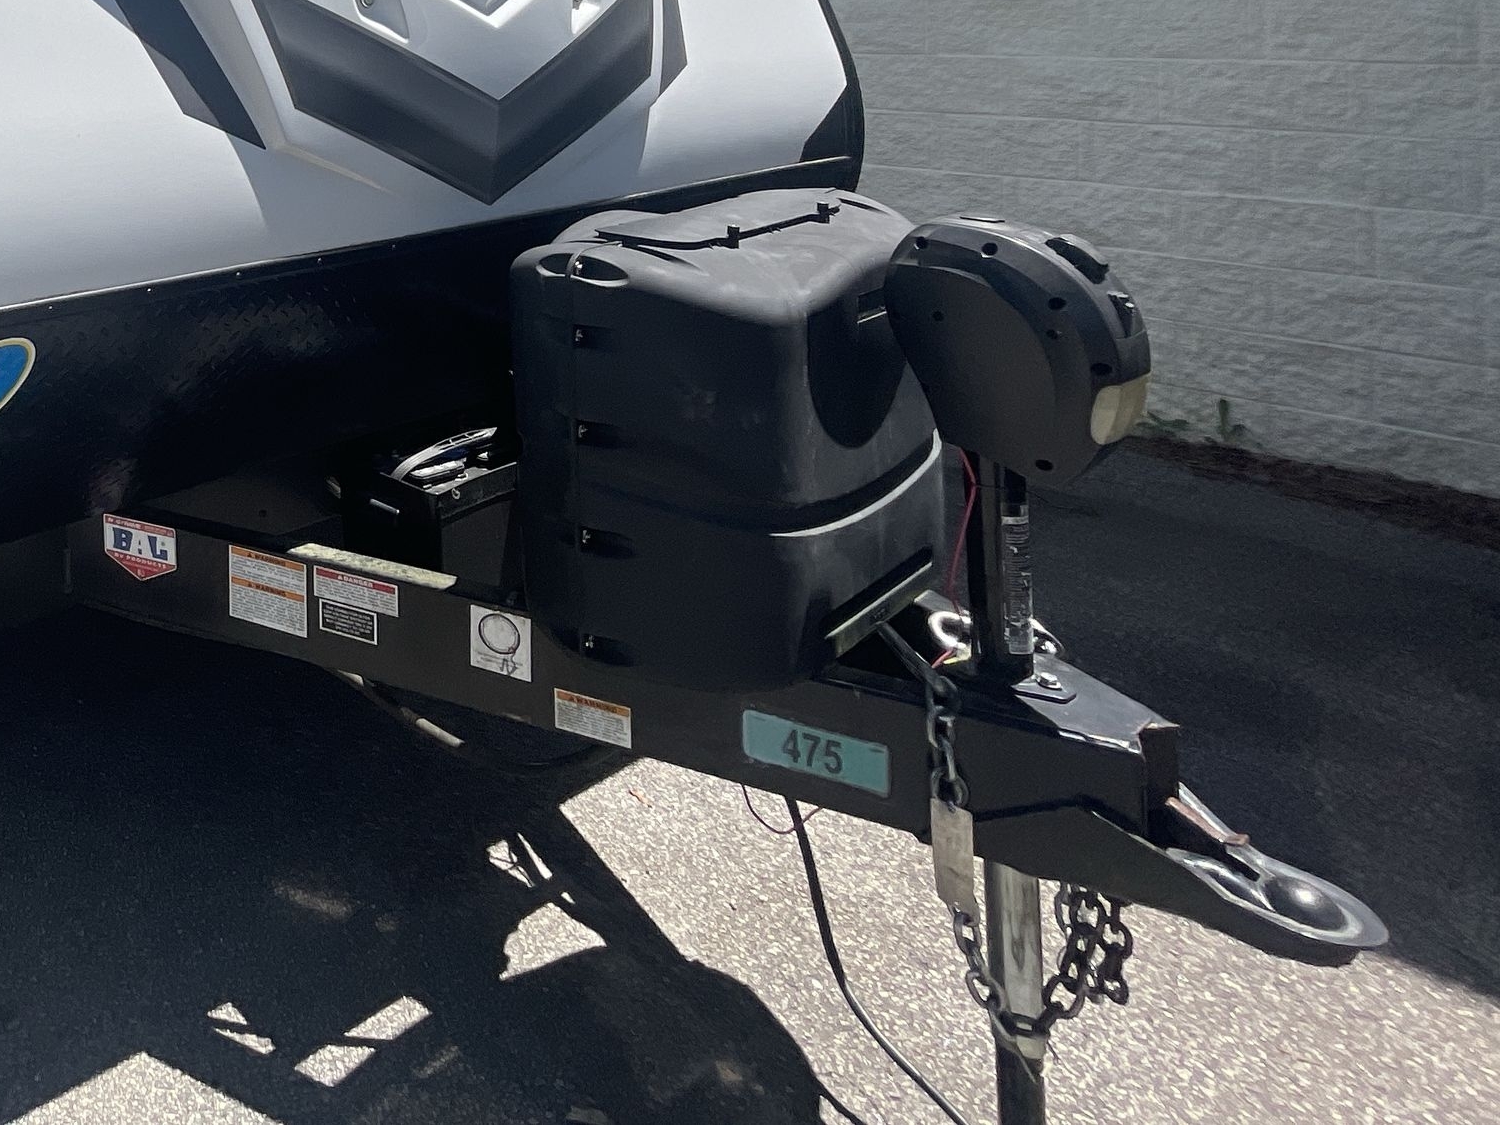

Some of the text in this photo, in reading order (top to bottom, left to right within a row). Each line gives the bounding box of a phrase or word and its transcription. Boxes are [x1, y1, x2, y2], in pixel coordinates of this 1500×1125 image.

[112, 526, 168, 561] BAL
[343, 576, 374, 588] DANGER
[781, 729, 843, 774] 475
